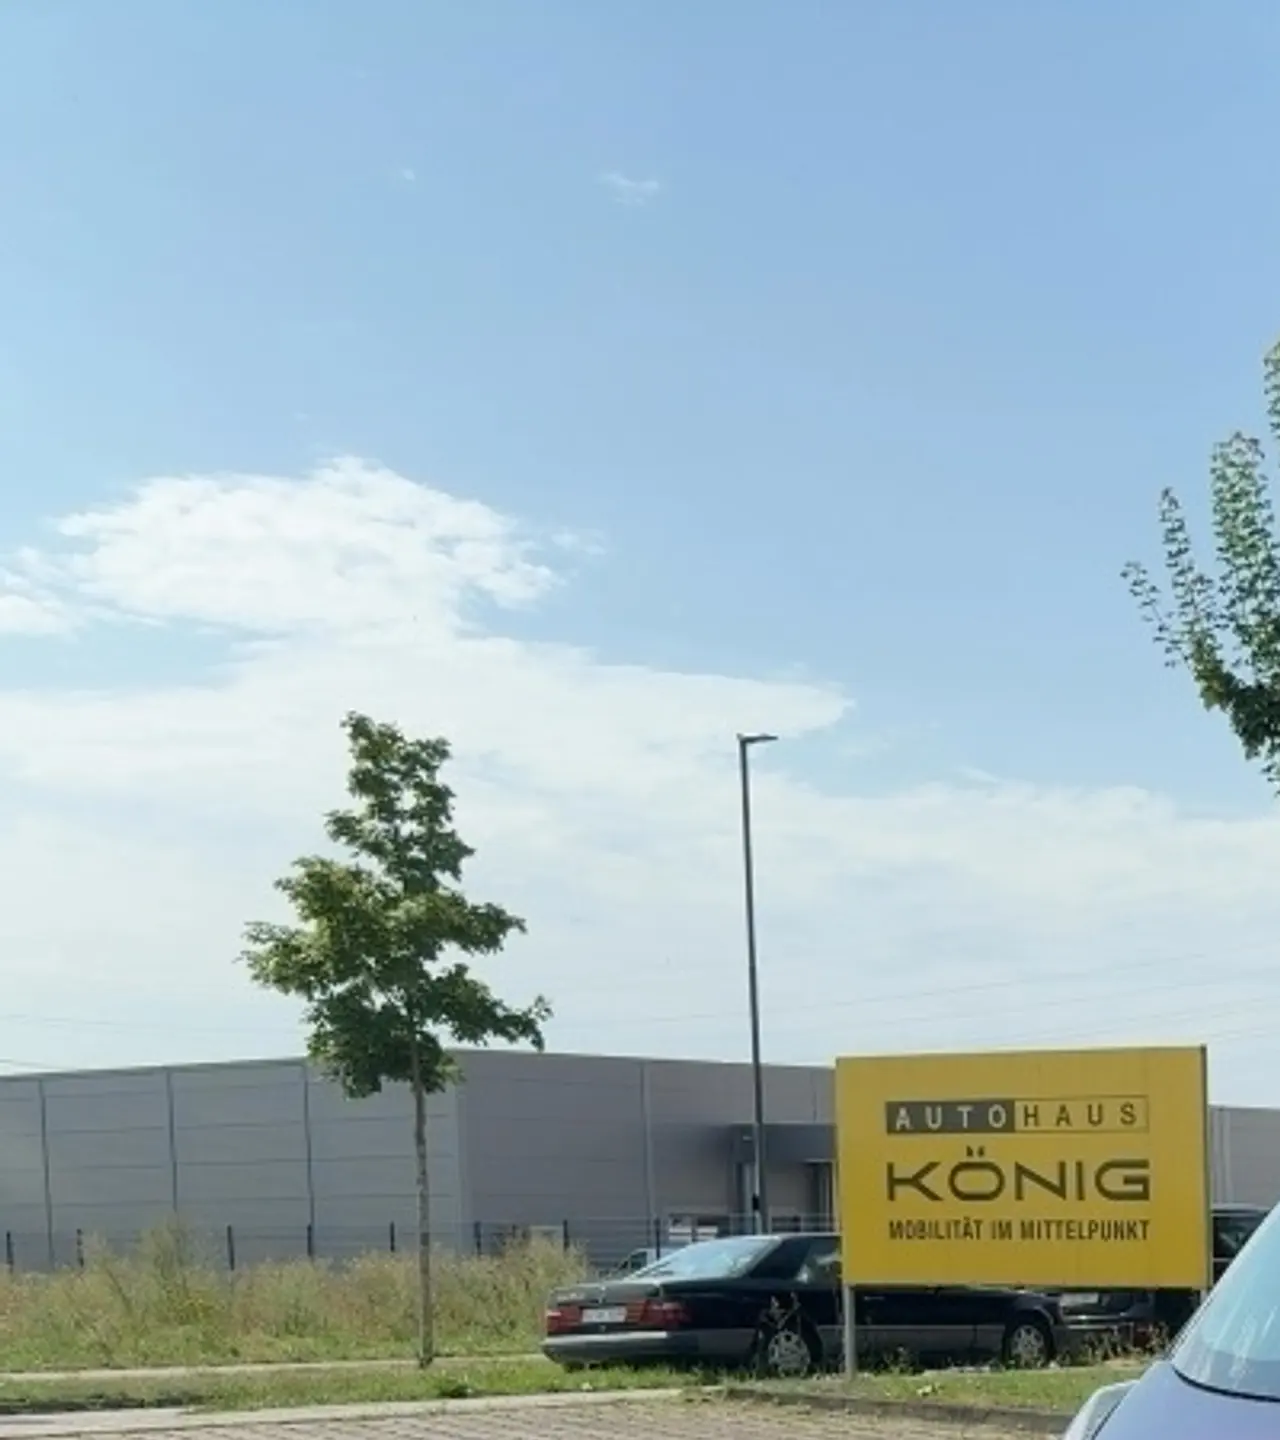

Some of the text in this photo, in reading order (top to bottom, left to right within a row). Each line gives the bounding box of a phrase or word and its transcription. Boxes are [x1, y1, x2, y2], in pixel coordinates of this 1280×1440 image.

[895, 1102, 1137, 1130] AUTOHAUS
[886, 1145, 1150, 1202] KÖNIG
[888, 1216, 1150, 1241] MOBILITÄT IM MITTELPUNKT
